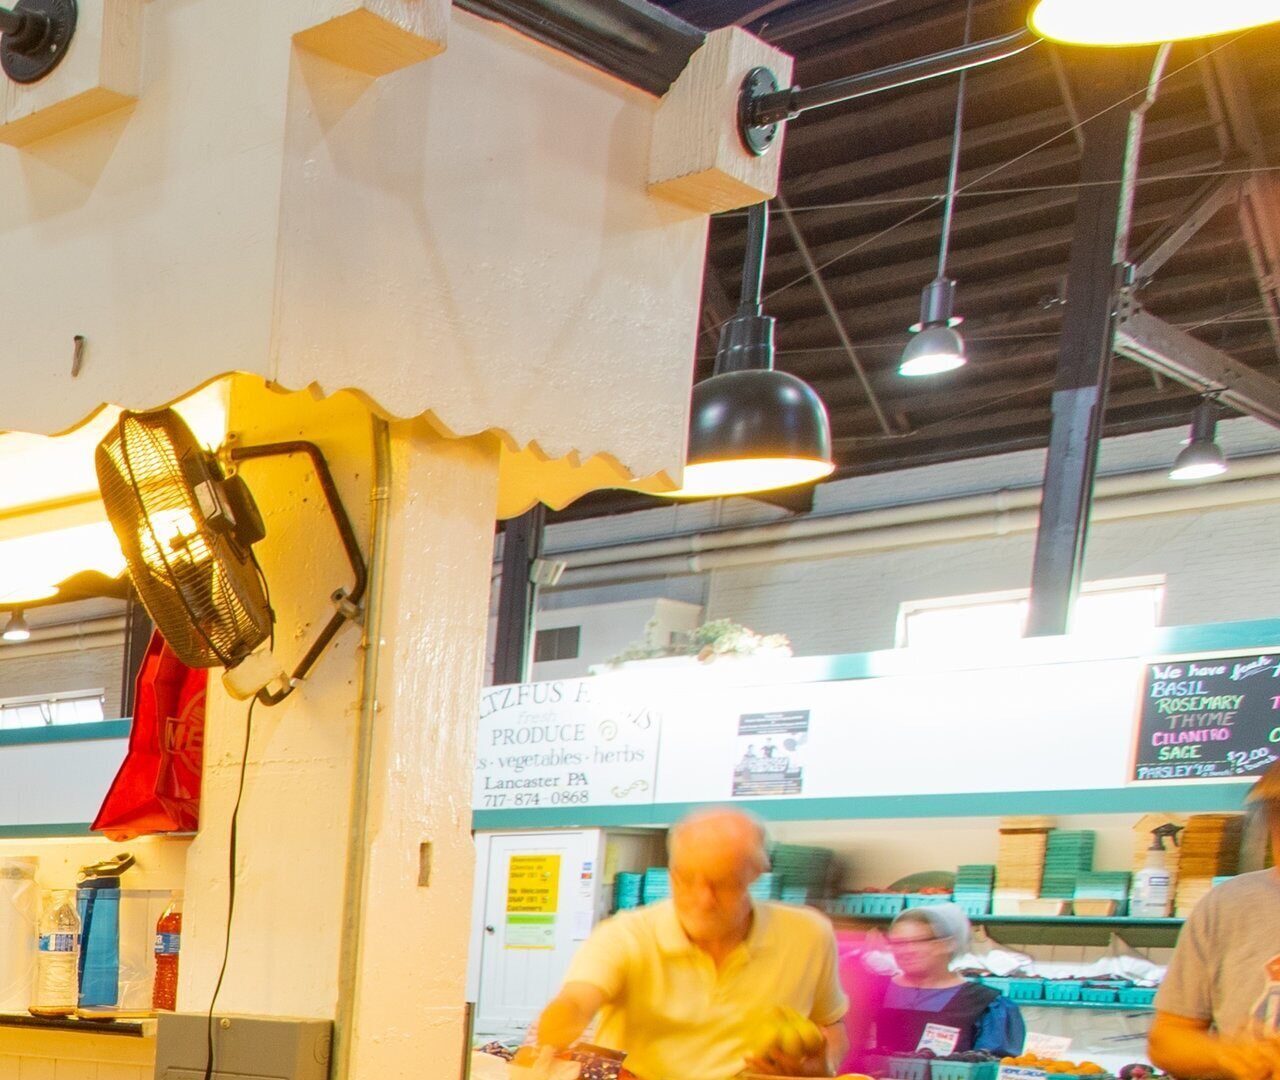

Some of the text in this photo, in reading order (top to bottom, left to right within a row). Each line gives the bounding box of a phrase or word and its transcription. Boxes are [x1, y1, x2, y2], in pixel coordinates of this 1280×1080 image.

[1151, 665, 1182, 679] We
[1188, 664, 1227, 677] have
[1150, 681, 1210, 697] BASIL
[1155, 695, 1245, 714] ROSEMARY
[1164, 711, 1238, 729] THYME
[492, 724, 585, 746] PRODUCE
[1151, 727, 1231, 746] CILANTRO
[499, 748, 582, 773] vegetables
[594, 745, 645, 764] herbs
[1158, 745, 1202, 761] SAGE
[1137, 764, 1193, 779] PARSLEY
[485, 773, 588, 790] Lancaster PA
